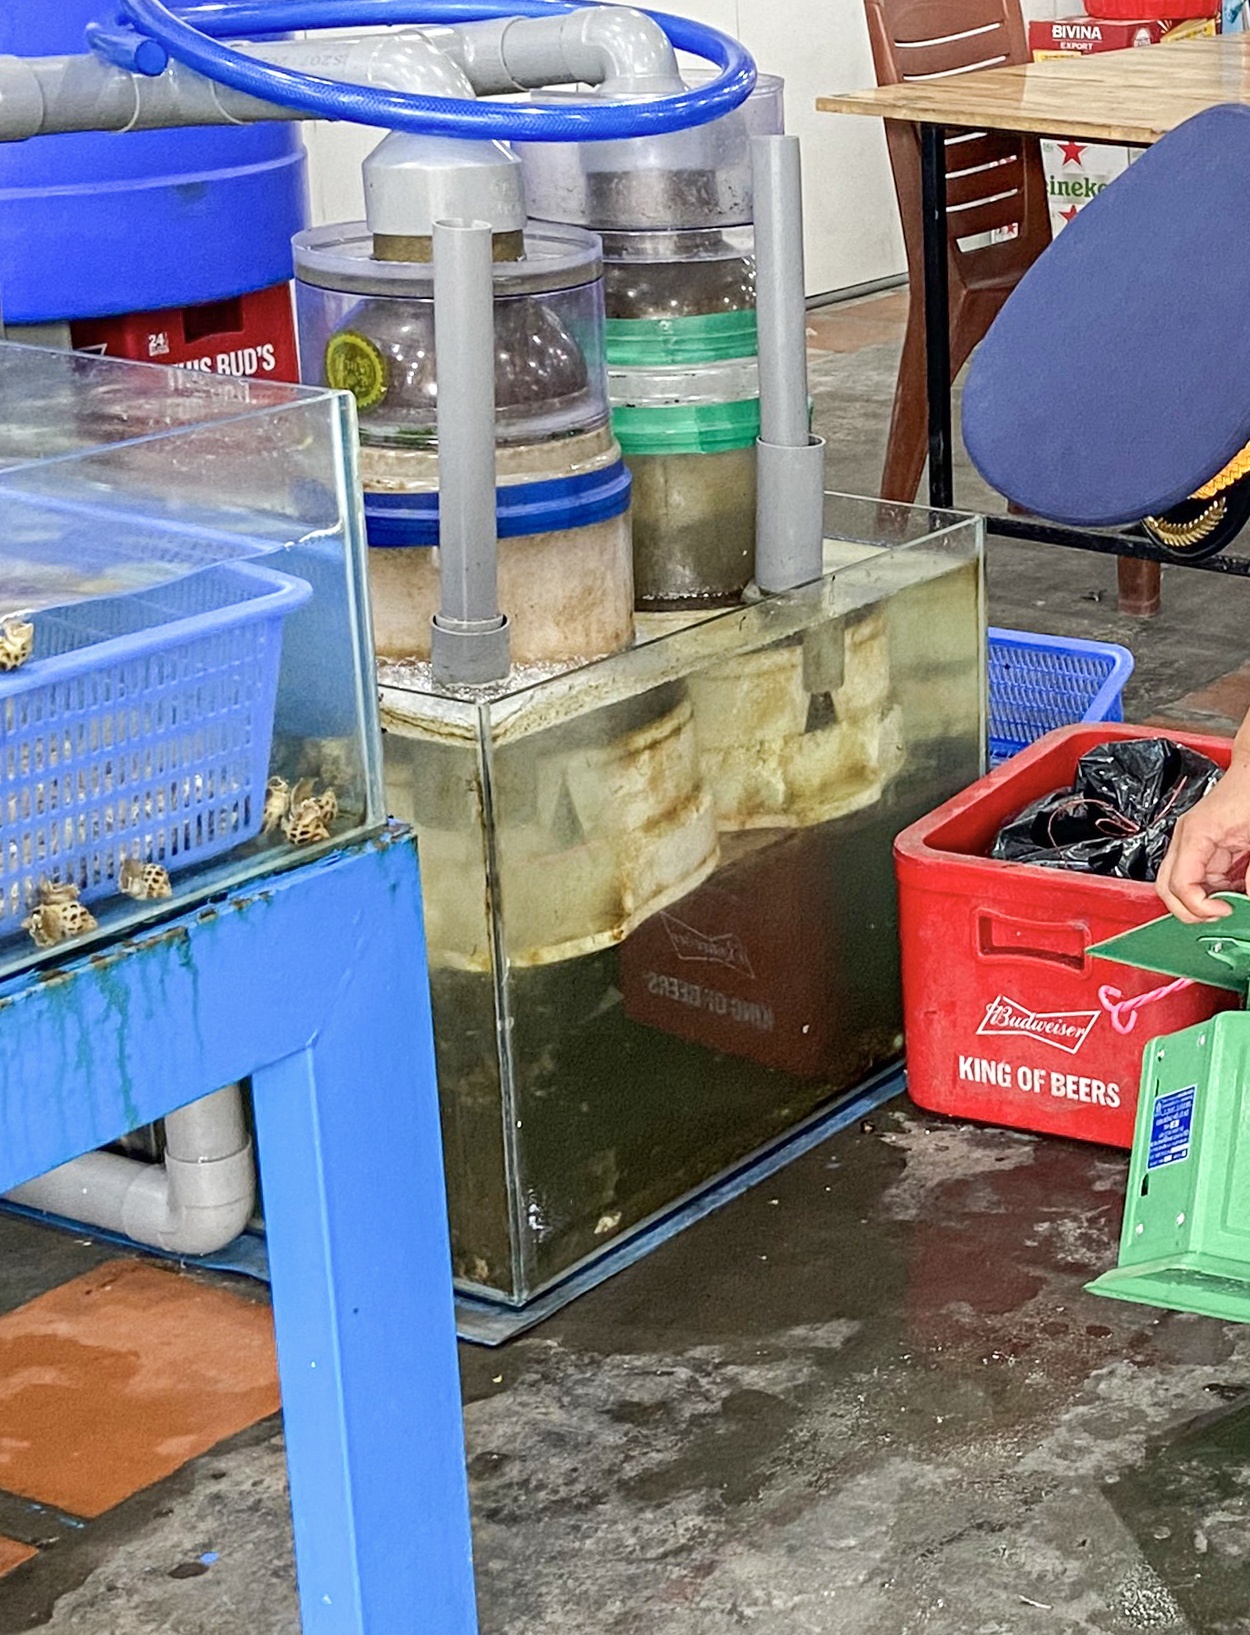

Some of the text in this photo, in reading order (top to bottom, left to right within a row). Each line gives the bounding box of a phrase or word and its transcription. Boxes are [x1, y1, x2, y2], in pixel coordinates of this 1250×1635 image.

[1052, 25, 1102, 40] BIVINA
[1060, 42, 1093, 50] EXPORT
[216, 343, 276, 377] BUD'S
[986, 1003, 1087, 1038] Budweiser
[959, 1055, 1120, 1108] KING OF BEERS
